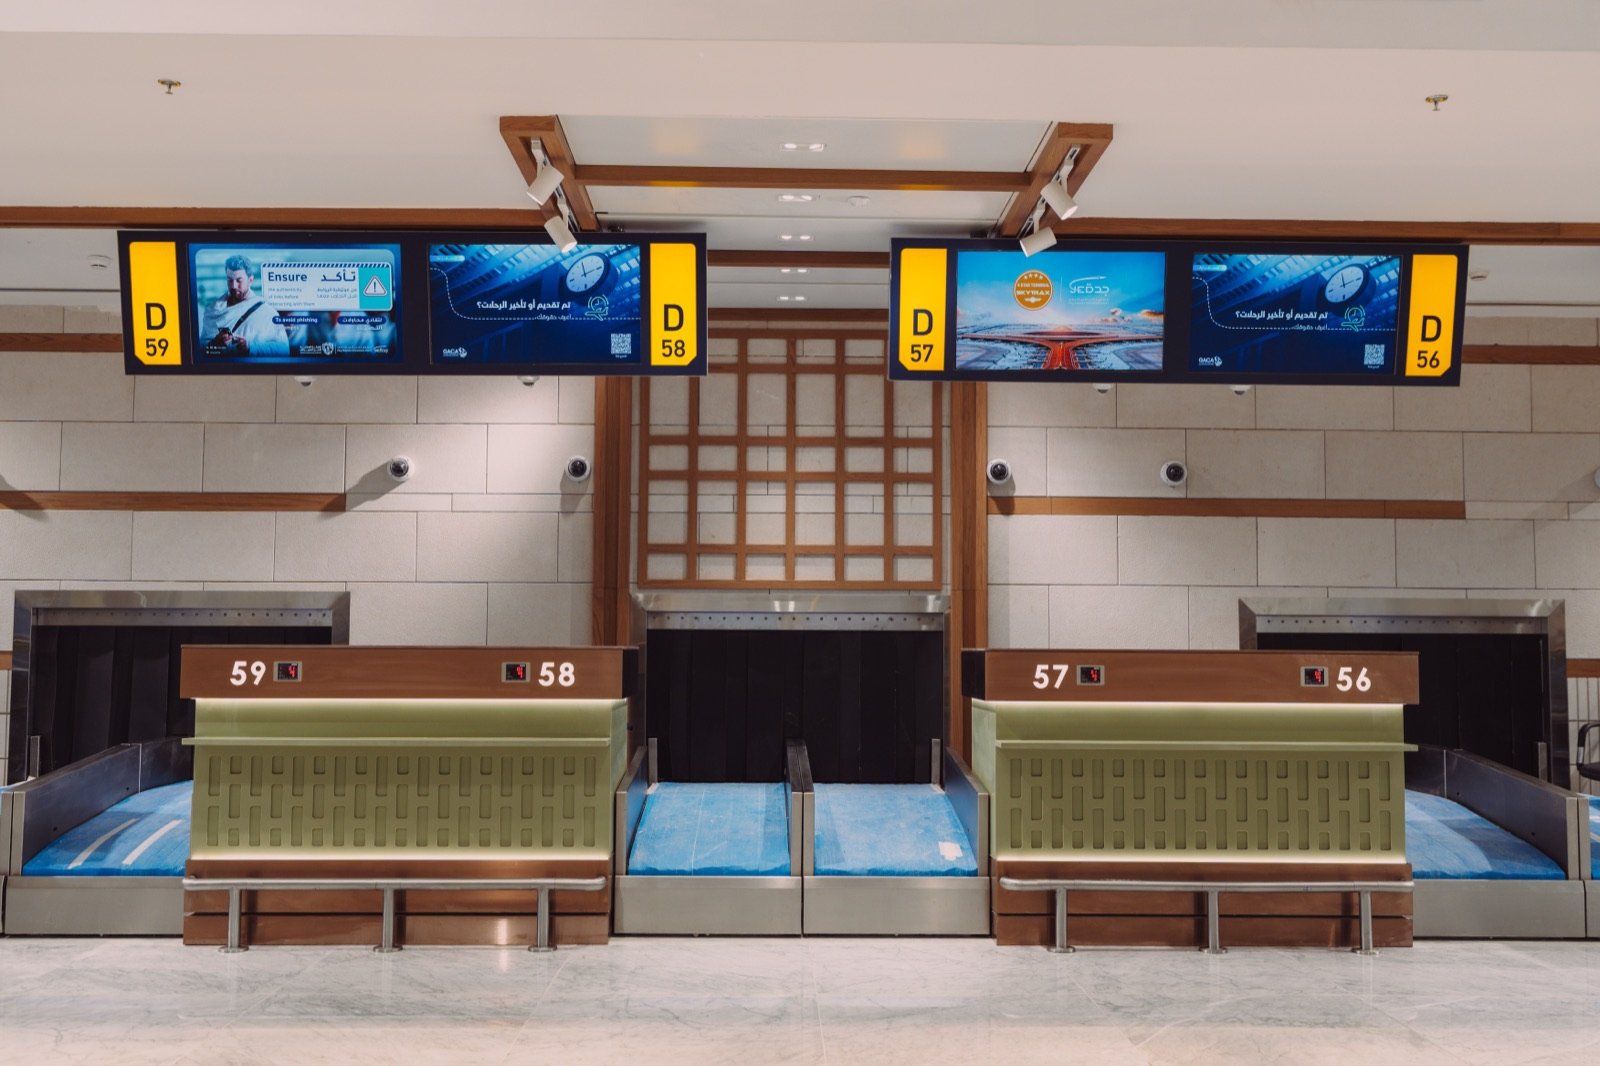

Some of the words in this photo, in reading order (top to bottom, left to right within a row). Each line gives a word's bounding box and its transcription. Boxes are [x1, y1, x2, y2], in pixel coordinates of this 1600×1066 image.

[268, 272, 307, 282] Ensure
[145, 302, 167, 330] D
[664, 304, 684, 331] D
[913, 309, 933, 336] D
[1421, 315, 1442, 342] D
[146, 338, 168, 357] 59
[662, 339, 685, 358] 58
[911, 344, 934, 362] 57
[1417, 350, 1440, 368] 56
[230, 661, 266, 685] 59
[538, 662, 575, 687] 58
[1033, 664, 1069, 689] 57
[1336, 667, 1371, 691] 56
